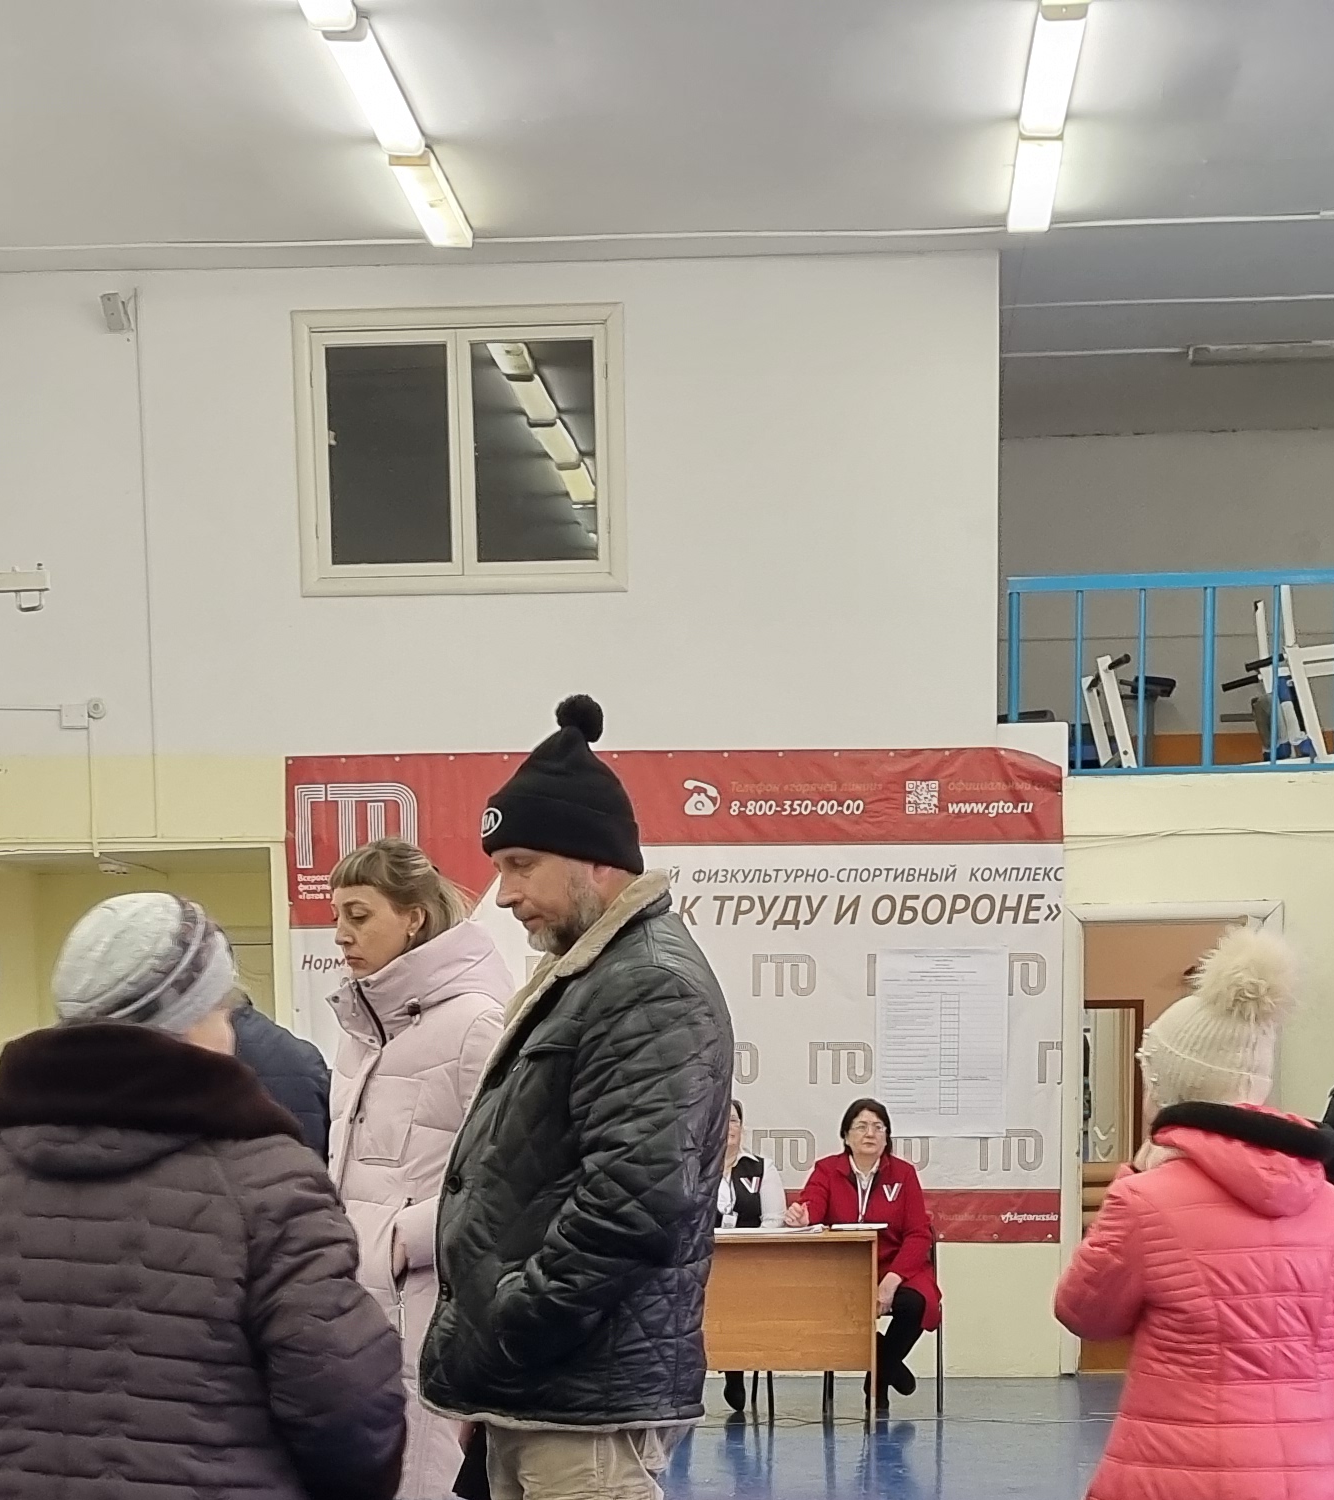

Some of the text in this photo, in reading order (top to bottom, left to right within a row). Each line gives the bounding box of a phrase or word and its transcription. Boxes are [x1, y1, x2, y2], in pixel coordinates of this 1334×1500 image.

[729, 799, 865, 816] 8-800-350-00-00
[948, 800, 1034, 818] www.gto.ru
[692, 864, 957, 884] ФИЗКУЛЬТУРНО-СПОРТИВНЫЙ
[968, 865, 1064, 883] КОМПЛЕКС
[712, 894, 828, 931] ТРУДУ
[834, 894, 862, 926] И
[870, 893, 1062, 926] ОБОРОНЕ»
[752, 953, 816, 997] ГТО
[809, 1041, 873, 1084] ГТО
